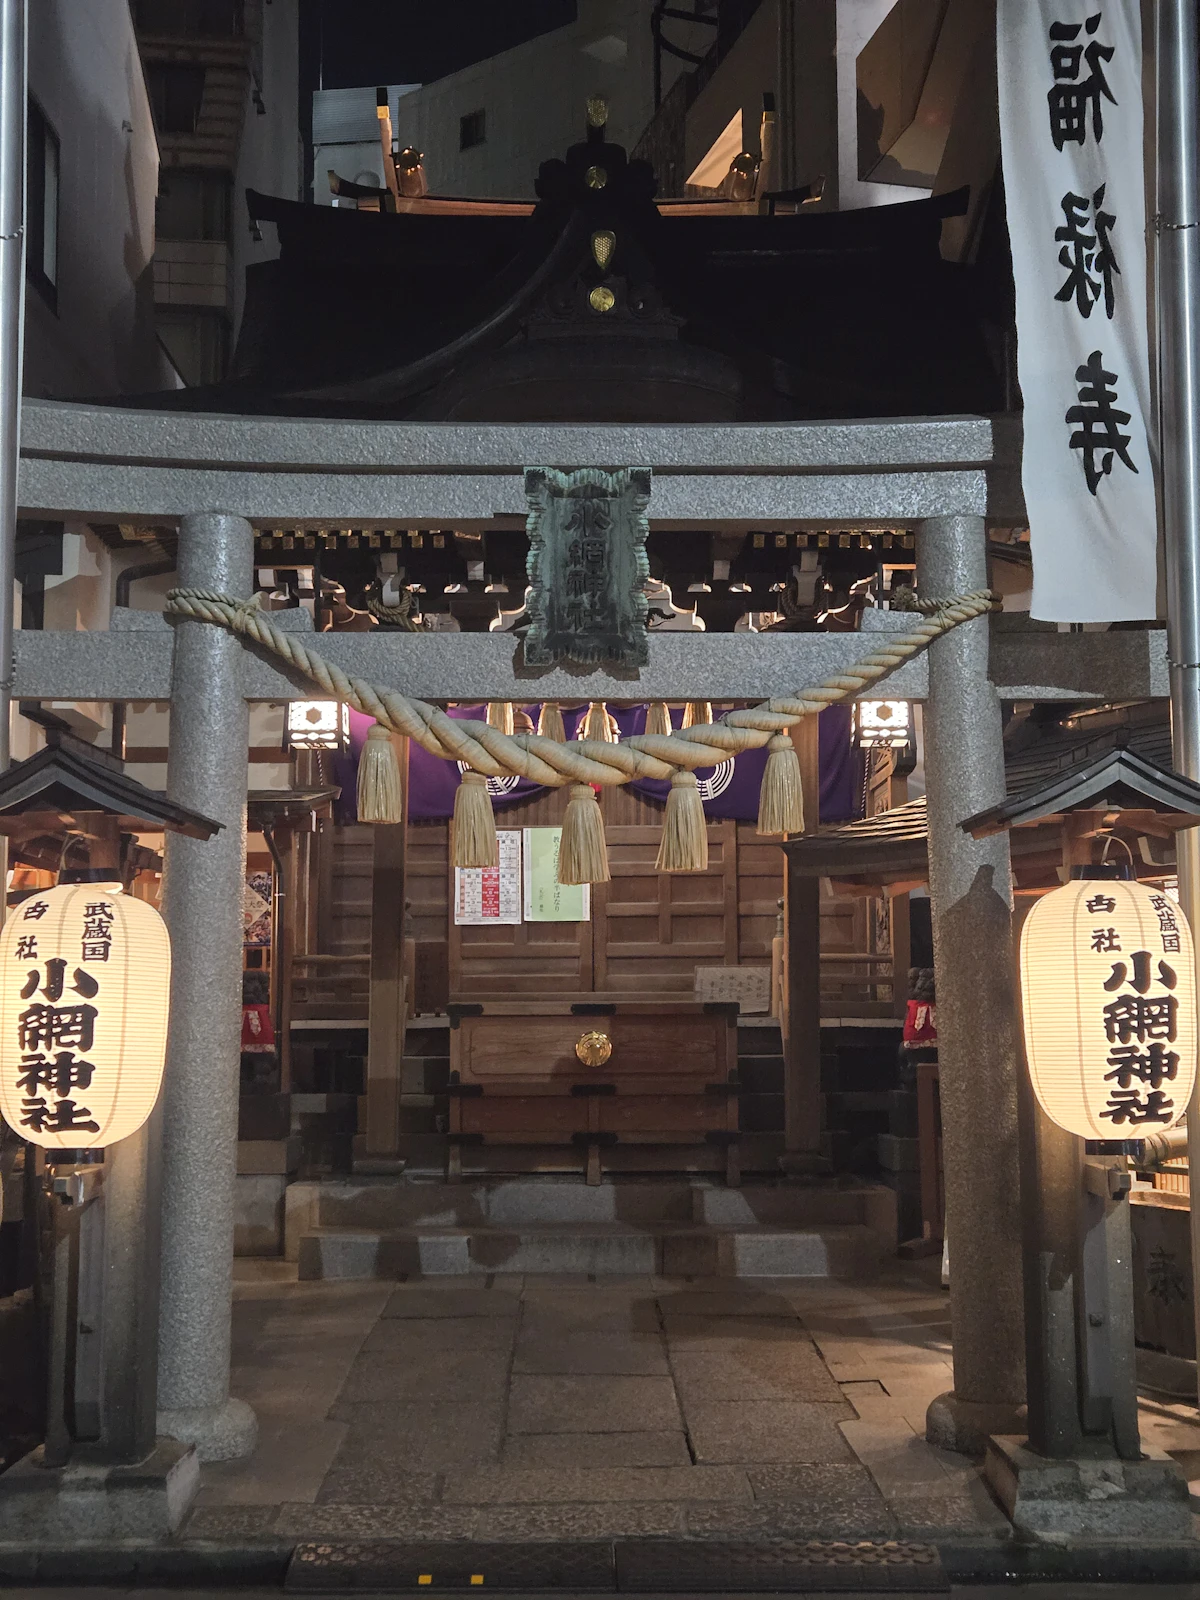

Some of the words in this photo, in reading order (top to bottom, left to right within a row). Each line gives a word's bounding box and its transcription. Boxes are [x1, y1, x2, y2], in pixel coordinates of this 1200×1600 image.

[81, 902, 115, 962] 武蔵国
[1149, 895, 1181, 954] 武蔵国
[16, 957, 100, 1134] 小網神社
[1099, 950, 1181, 1125] 小網神社
